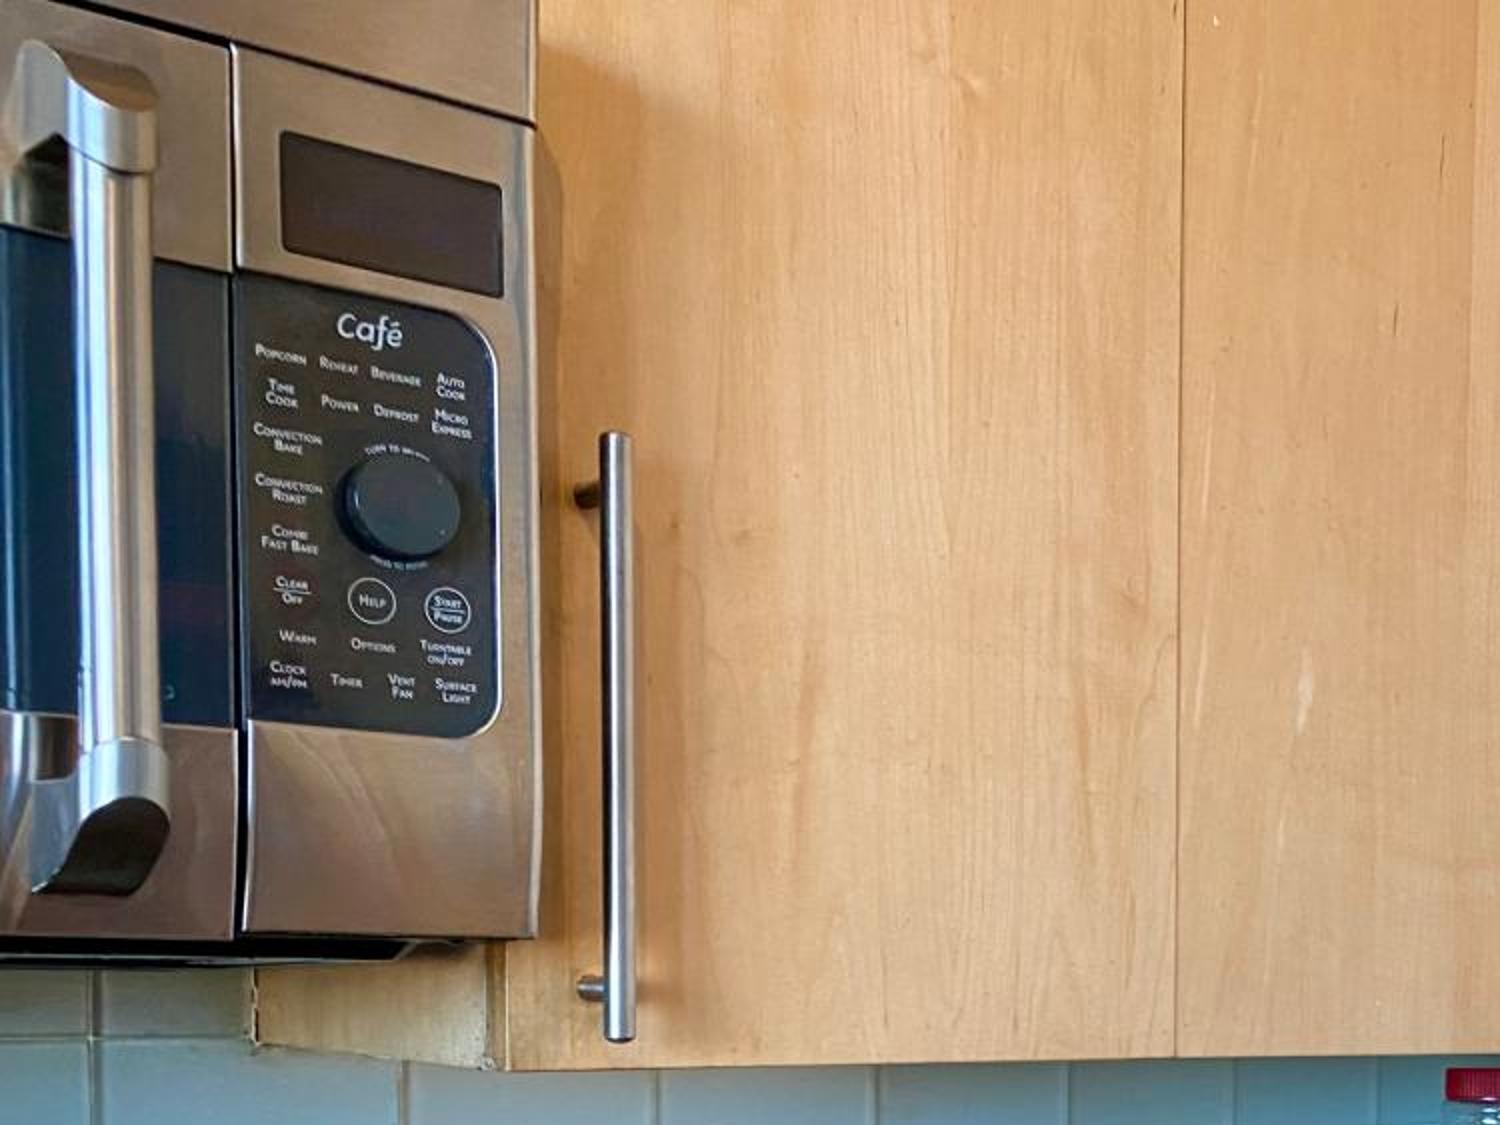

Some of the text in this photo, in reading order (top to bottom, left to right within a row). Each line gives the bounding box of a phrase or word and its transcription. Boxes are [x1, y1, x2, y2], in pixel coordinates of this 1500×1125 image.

[337, 313, 403, 350] Café
[255, 343, 307, 366] POPCORN
[371, 366, 422, 387] BEVERAGE
[268, 377, 295, 395] TIME
[437, 373, 465, 389] AUTO
[265, 391, 299, 408] COOK
[436, 386, 466, 401] COOK
[321, 394, 419, 422] POWER DEFROST
[435, 408, 469, 425] MICRO
[253, 422, 323, 445] CONVECTION
[431, 422, 472, 439] EXPRESS
[274, 439, 304, 455] BAKE
[255, 473, 323, 494] CONVECTION
[261, 536, 319, 556] FAST BAKE
[275, 575, 309, 590] CLEAR
[282, 592, 303, 605] OFF
[359, 593, 387, 609] HELP
[434, 595, 463, 609] START
[434, 610, 463, 624] PAUSE
[279, 630, 397, 653] WARM OPTIONS
[270, 660, 306, 676] CLOCK
[331, 673, 363, 688] TIMER
[388, 672, 416, 687] VENT
[435, 678, 477, 695] SURFACE
[391, 687, 413, 700] FAN
[442, 692, 471, 705] LIGHT
